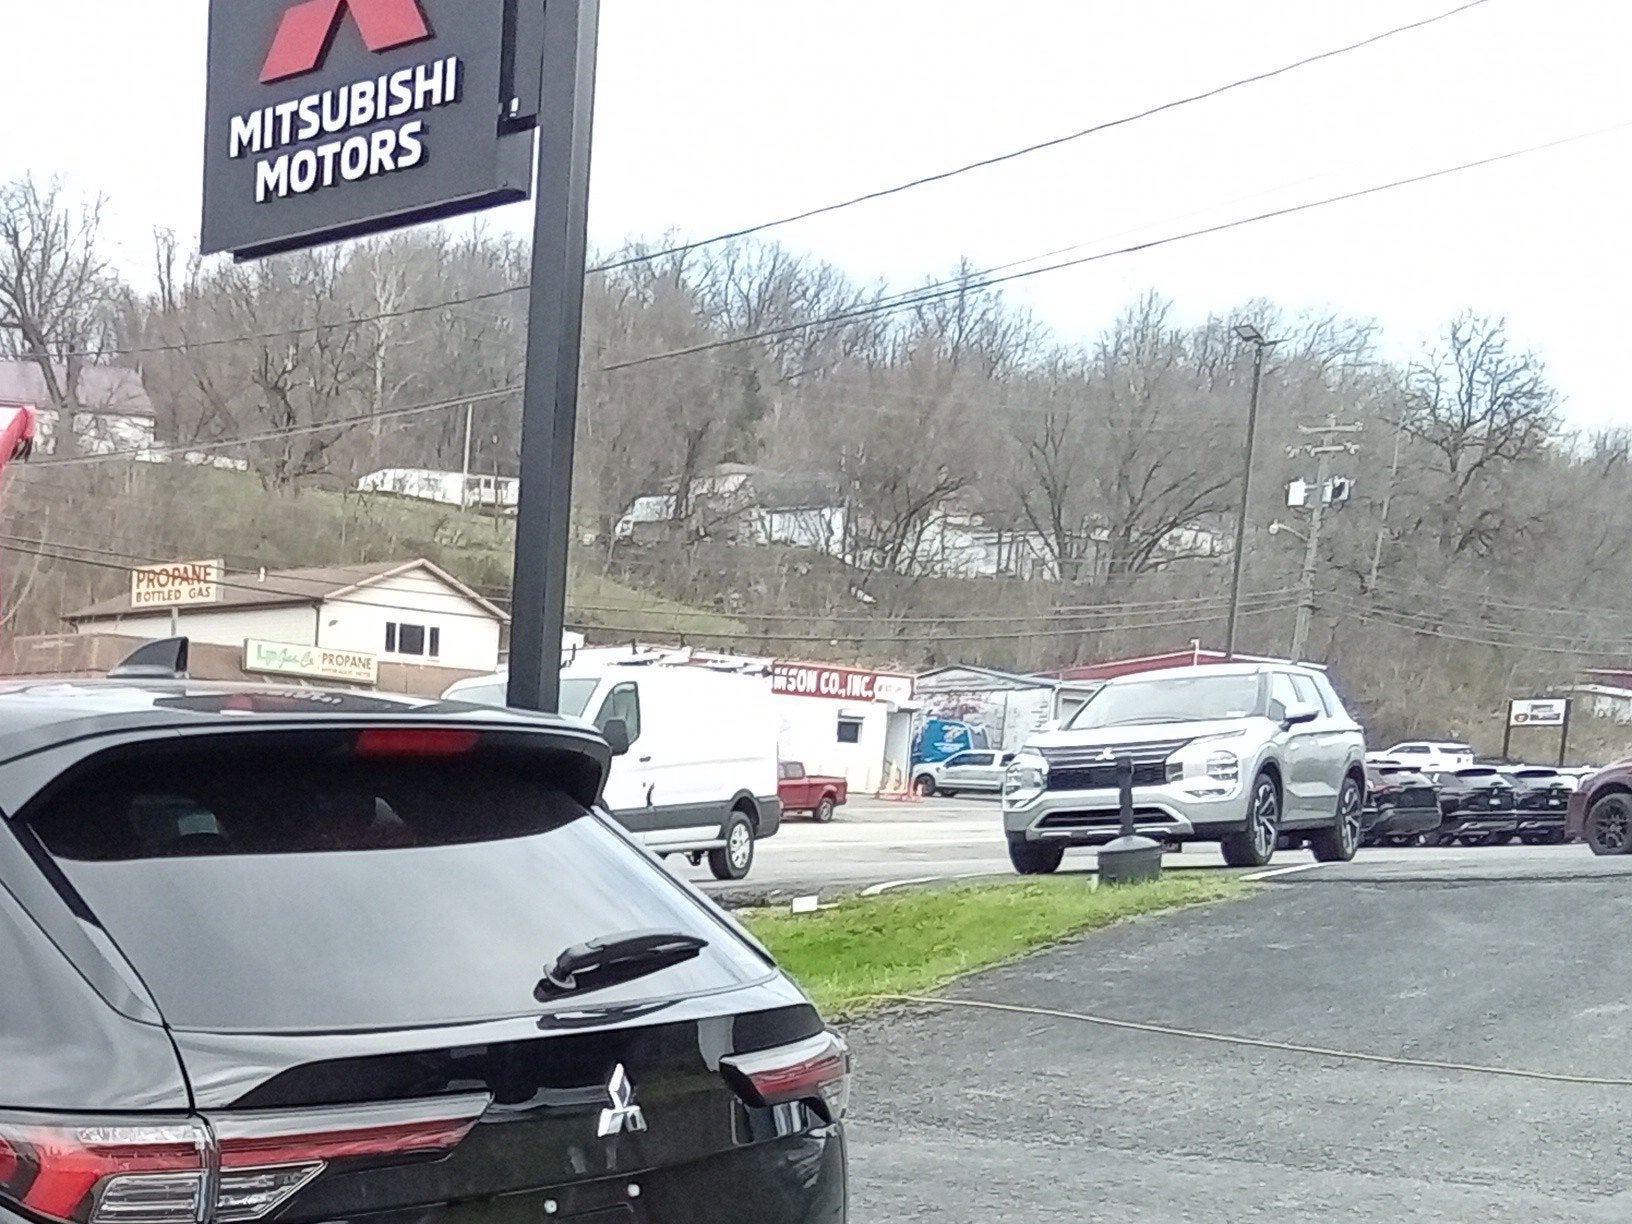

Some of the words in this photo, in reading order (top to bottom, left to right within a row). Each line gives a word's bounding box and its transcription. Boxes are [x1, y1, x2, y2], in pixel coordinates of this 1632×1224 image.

[229, 56, 458, 158] MITSUBISHI
[255, 120, 424, 203] MOTORS
[136, 564, 211, 589] PROPANE
[136, 588, 182, 603] BOTTLED
[189, 586, 211, 599] GAS
[321, 652, 372, 670] PROPANE
